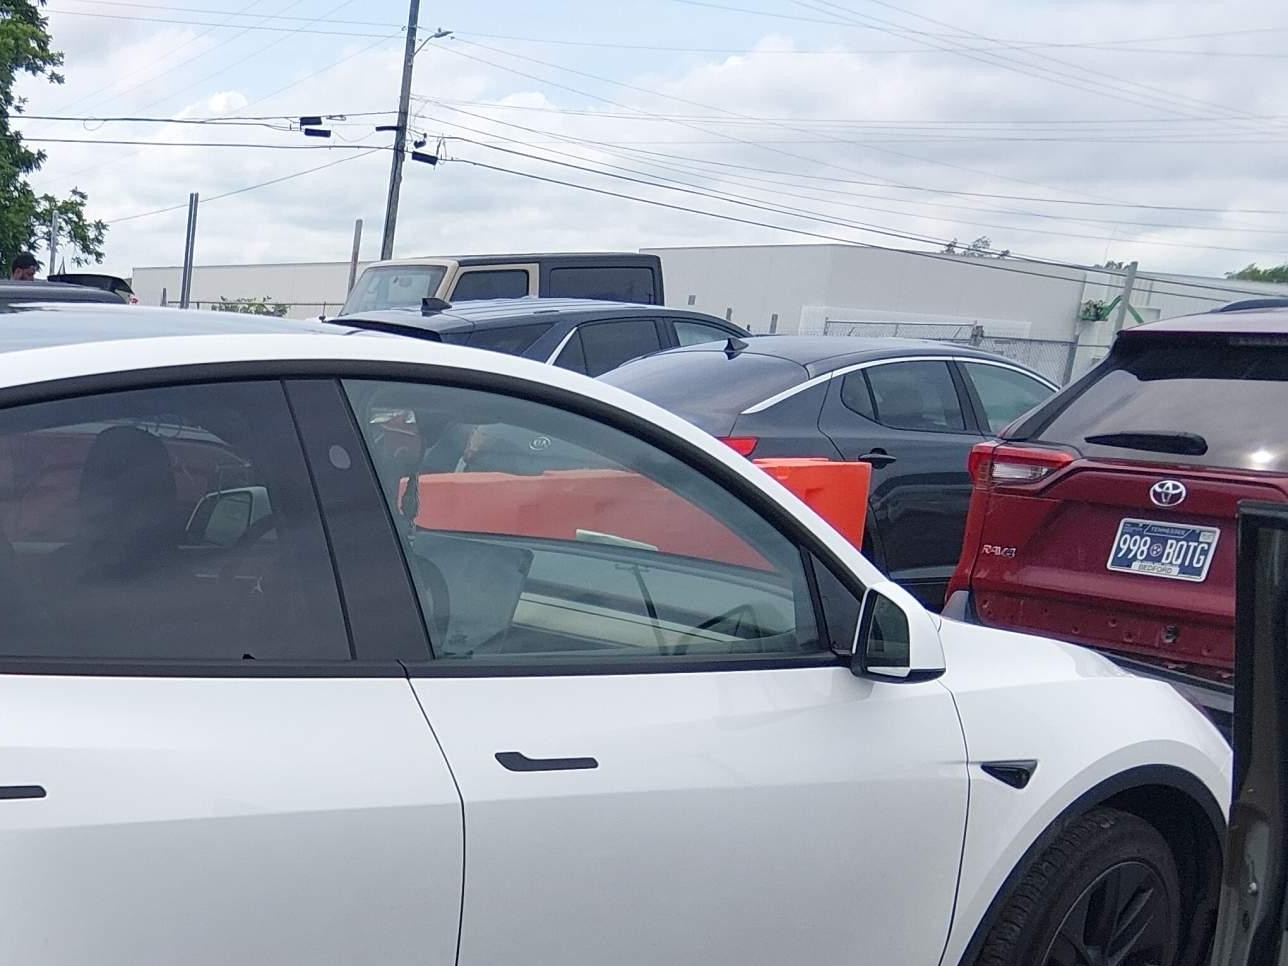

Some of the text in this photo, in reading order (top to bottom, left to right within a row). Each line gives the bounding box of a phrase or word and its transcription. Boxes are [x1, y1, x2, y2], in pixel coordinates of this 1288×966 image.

[1117, 534, 1208, 568] 998 BQTG
[1138, 564, 1173, 575] BEDFORD
